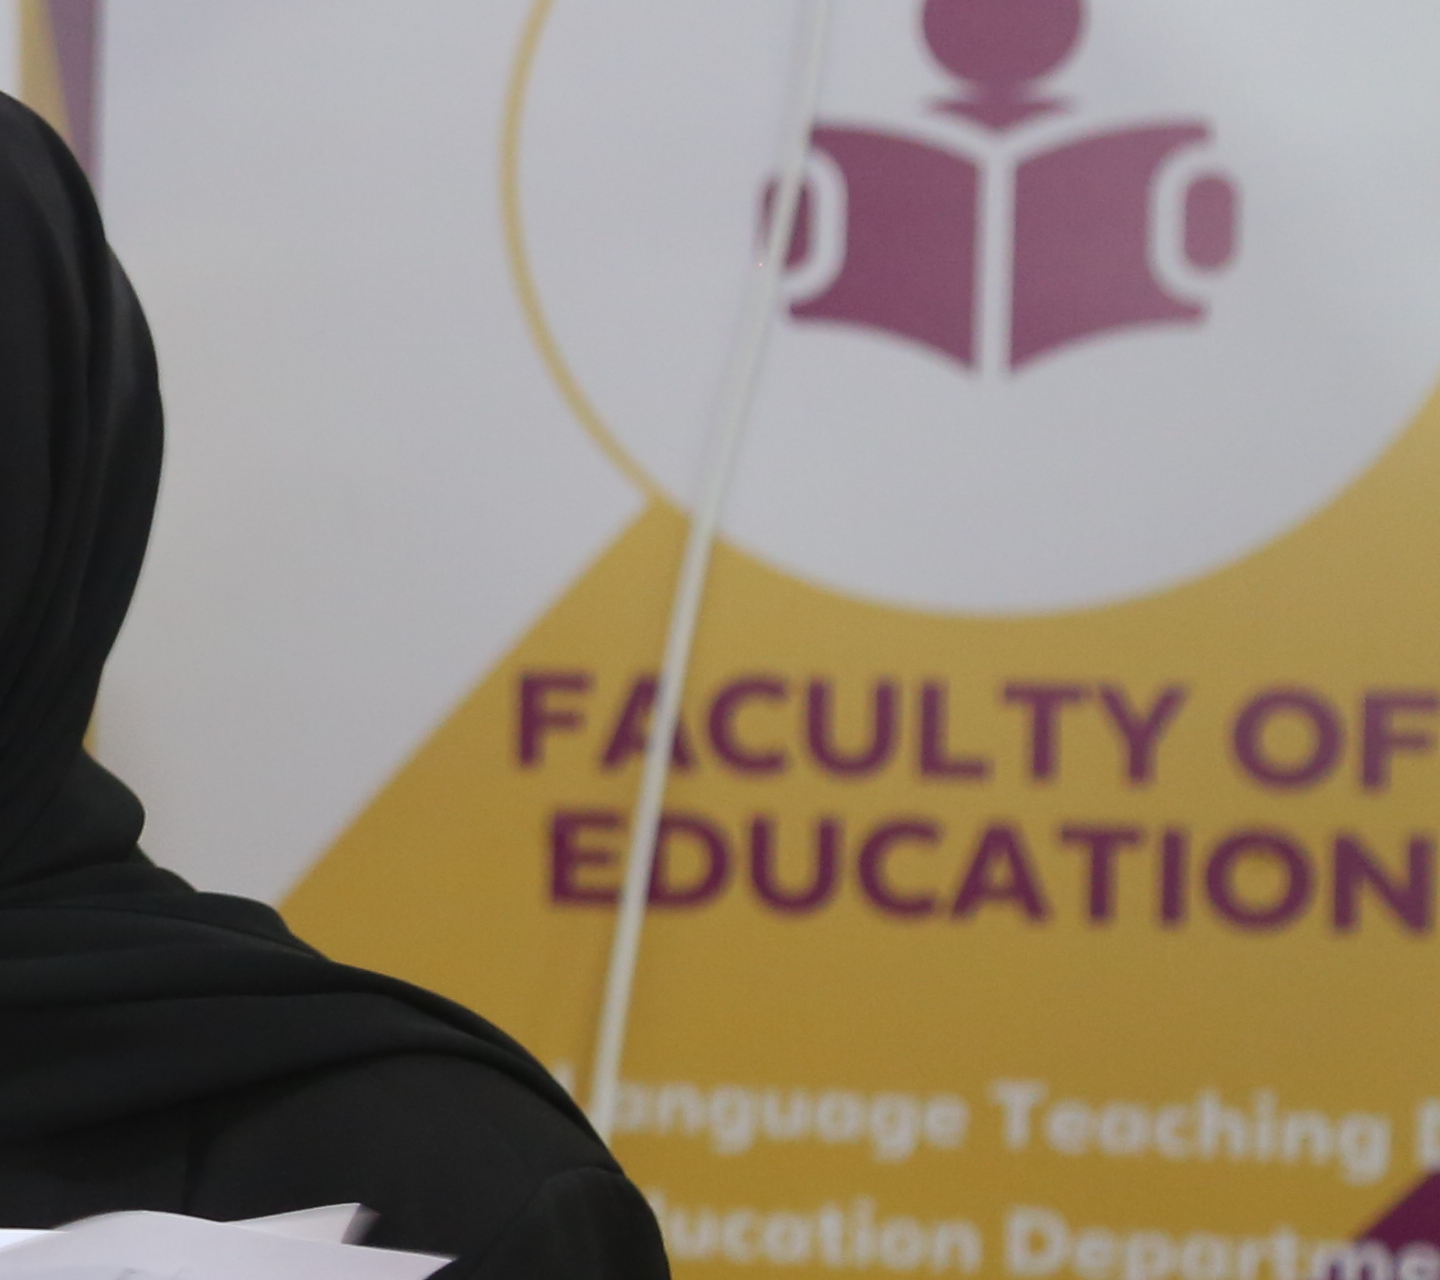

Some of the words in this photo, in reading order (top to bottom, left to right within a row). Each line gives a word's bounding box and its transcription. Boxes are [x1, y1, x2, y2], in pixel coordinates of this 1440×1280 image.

[512, 666, 1191, 788] FACULTY
[1230, 684, 1440, 794] OF
[544, 810, 1439, 937] EDUCATION
[990, 1080, 1391, 1186] Teaching
